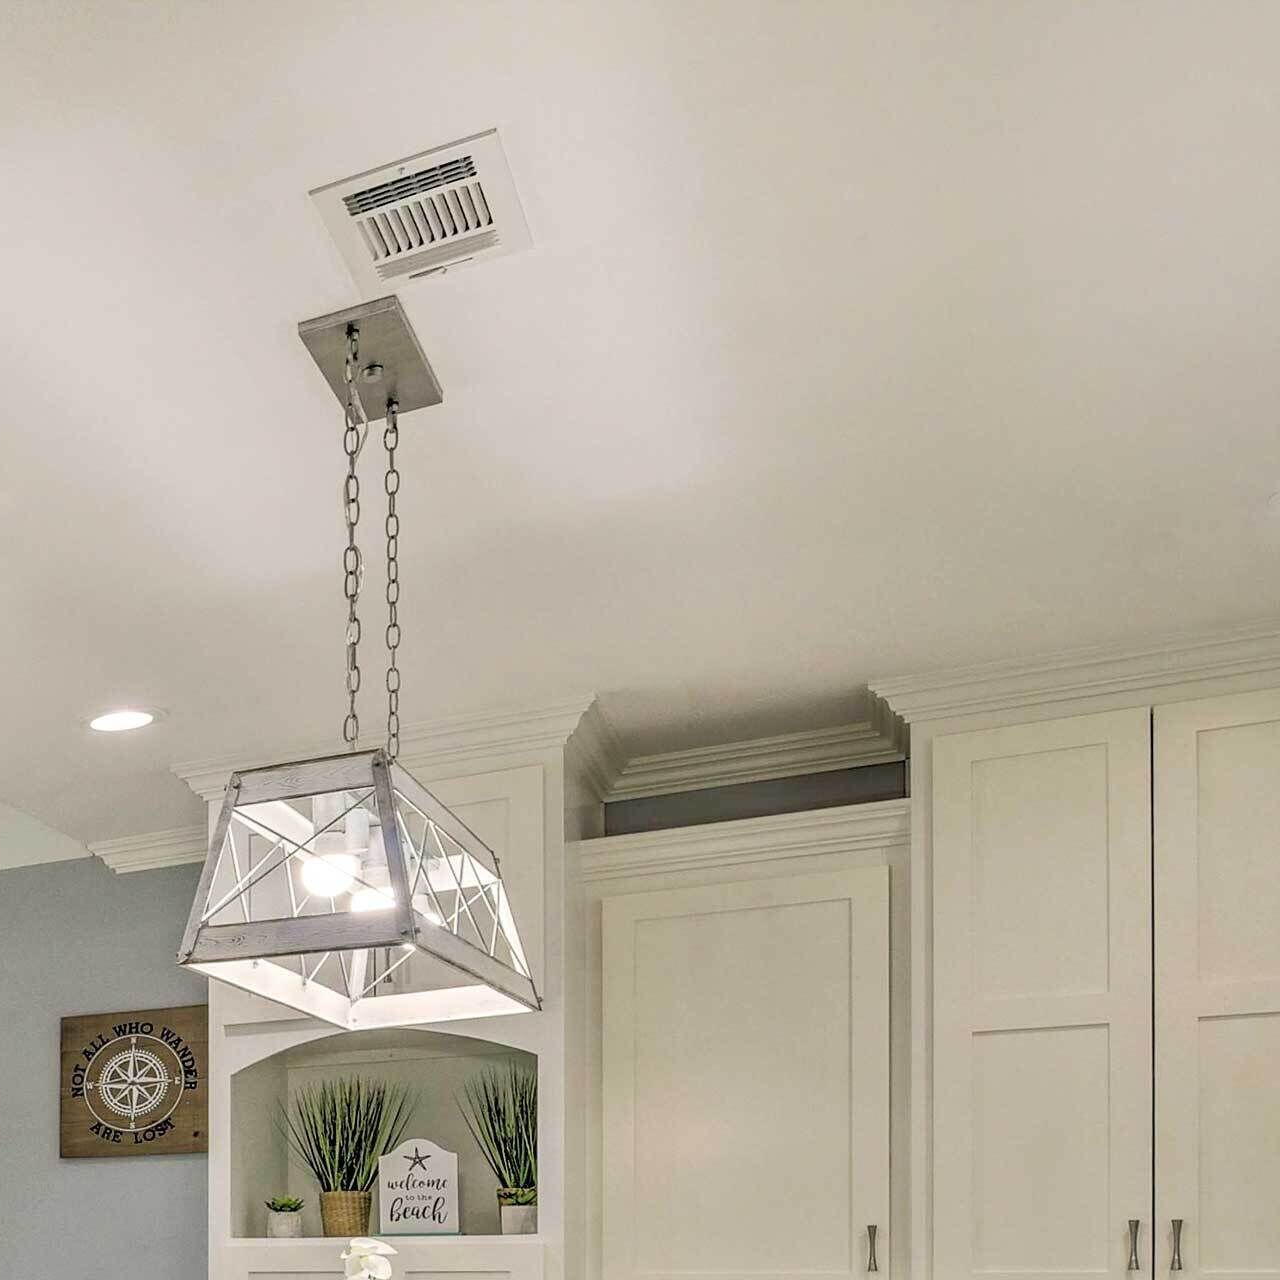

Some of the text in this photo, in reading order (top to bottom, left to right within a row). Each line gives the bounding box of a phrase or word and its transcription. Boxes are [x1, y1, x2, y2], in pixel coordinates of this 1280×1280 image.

[71, 1022, 198, 1098] NOT ALL WHO WANDER
[90, 1117, 176, 1144] ARE LOST
[387, 1172, 448, 1191] welcome
